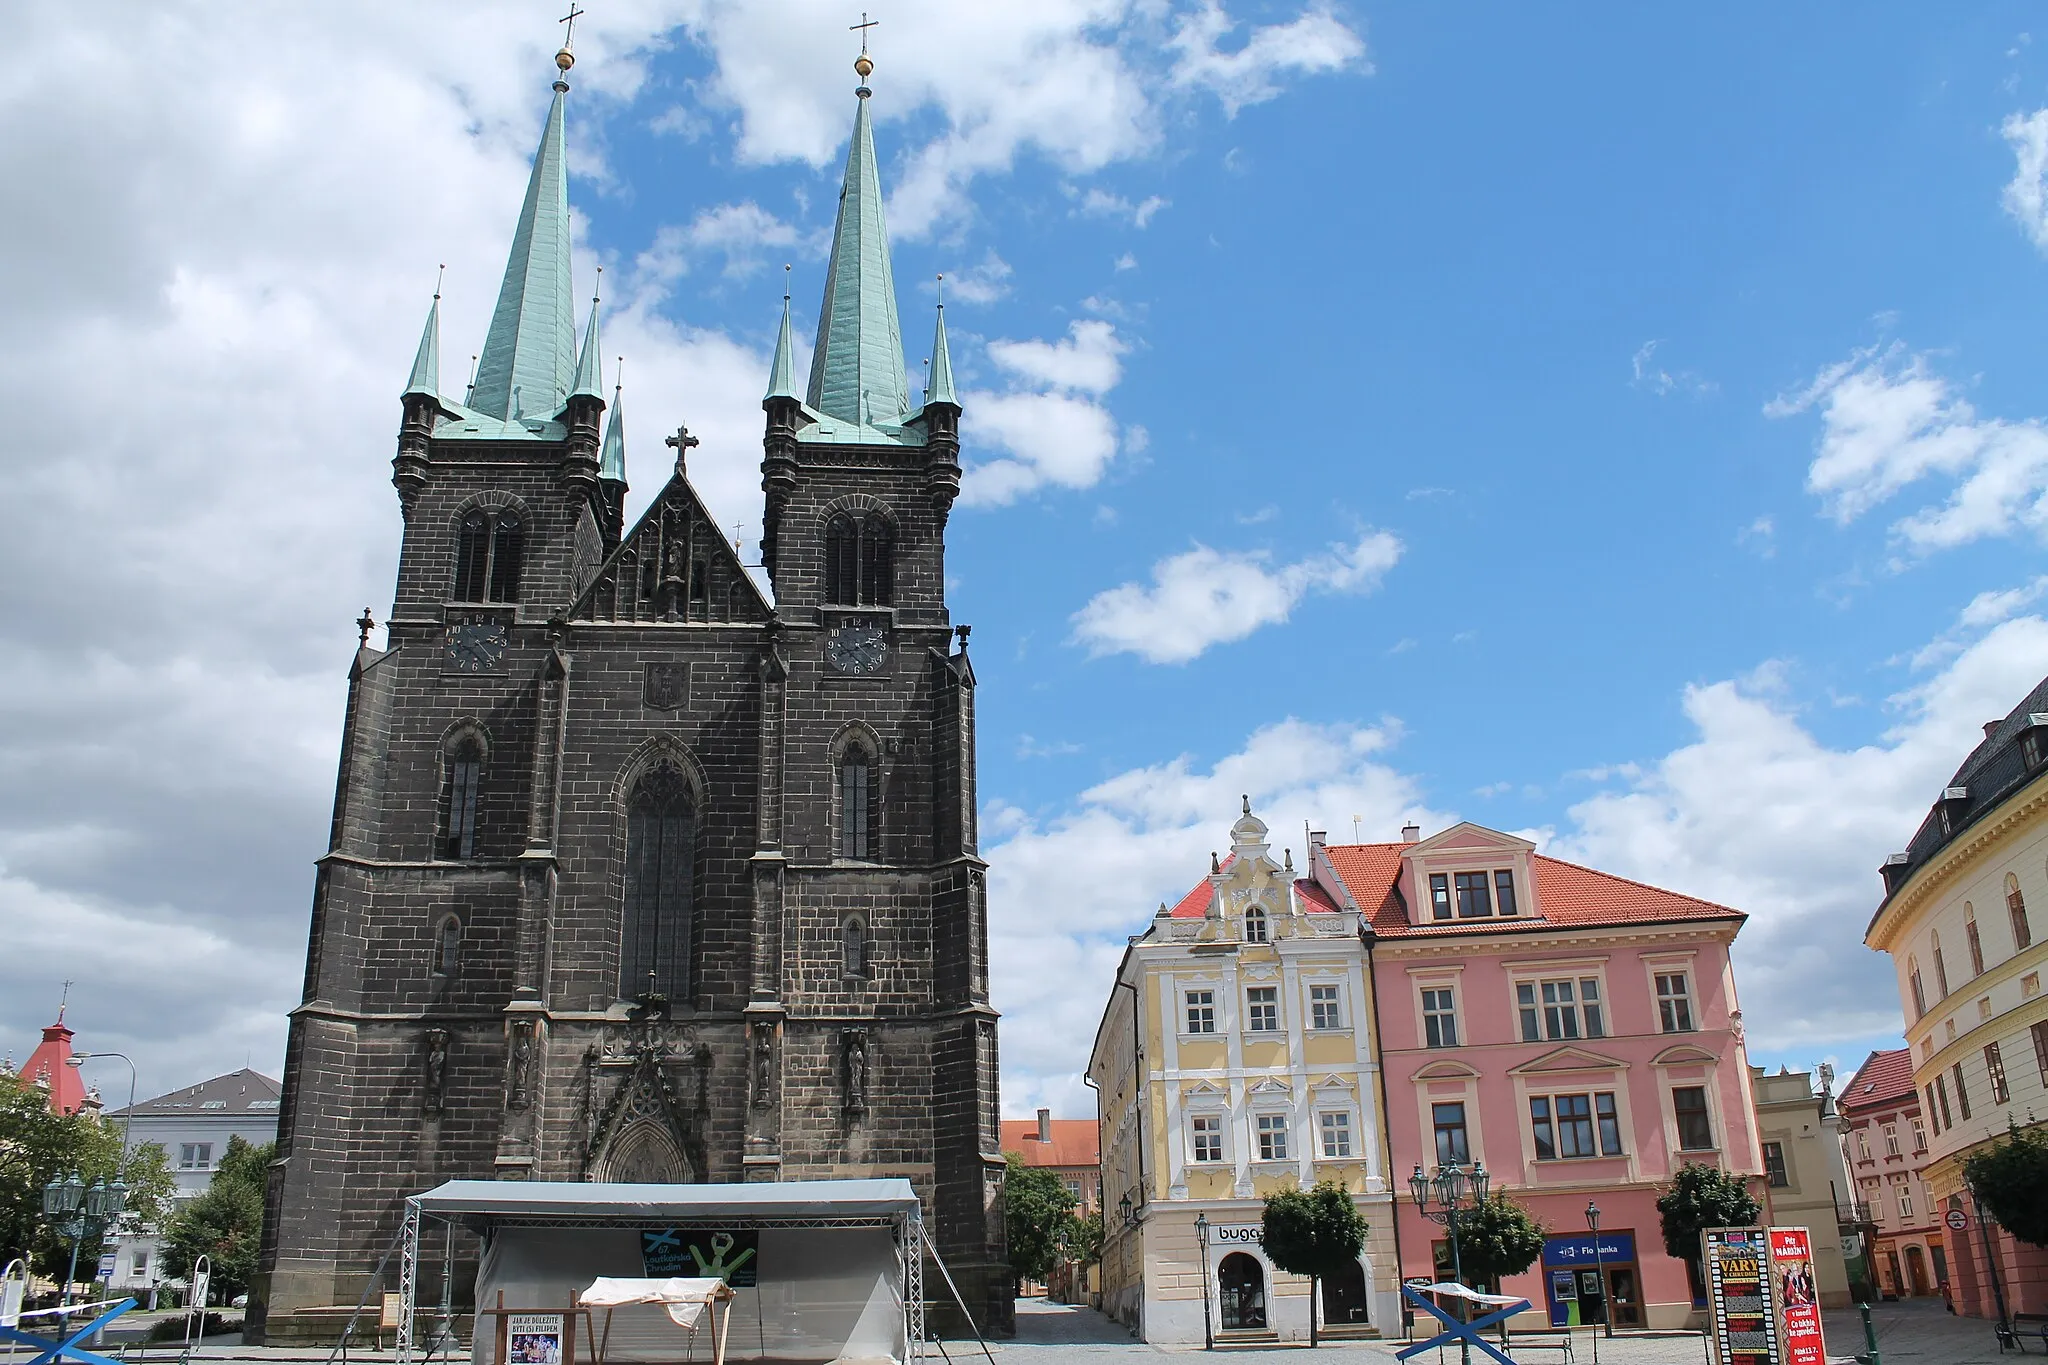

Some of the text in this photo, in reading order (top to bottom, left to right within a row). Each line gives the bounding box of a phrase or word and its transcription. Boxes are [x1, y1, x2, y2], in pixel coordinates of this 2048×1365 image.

[463, 617, 470, 626] 11
[475, 614, 484, 623] 12
[491, 617, 495, 626] 1
[853, 617, 861, 626] 12
[841, 620, 847, 629] 11
[869, 621, 872, 630] 1
[451, 626, 461, 634] 10
[499, 626, 505, 635] 2
[831, 628, 840, 637] 10
[877, 630, 883, 639] 2
[447, 638, 454, 646] 9
[500, 638, 508, 647] 3
[828, 641, 834, 649] 9
[880, 642, 887, 651] 3
[450, 650, 456, 659] 8
[496, 651, 503, 660] 4
[831, 653, 838, 661] 8
[876, 654, 883, 663] 4
[459, 659, 466, 668] 7
[472, 662, 478, 671] 6
[485, 660, 493, 668] 5
[841, 663, 847, 671] 7
[867, 663, 874, 672] 5
[853, 665, 860, 674] 6
[645, 1263, 681, 1273] Chrudim
[1720, 1259, 1759, 1272] VARY
